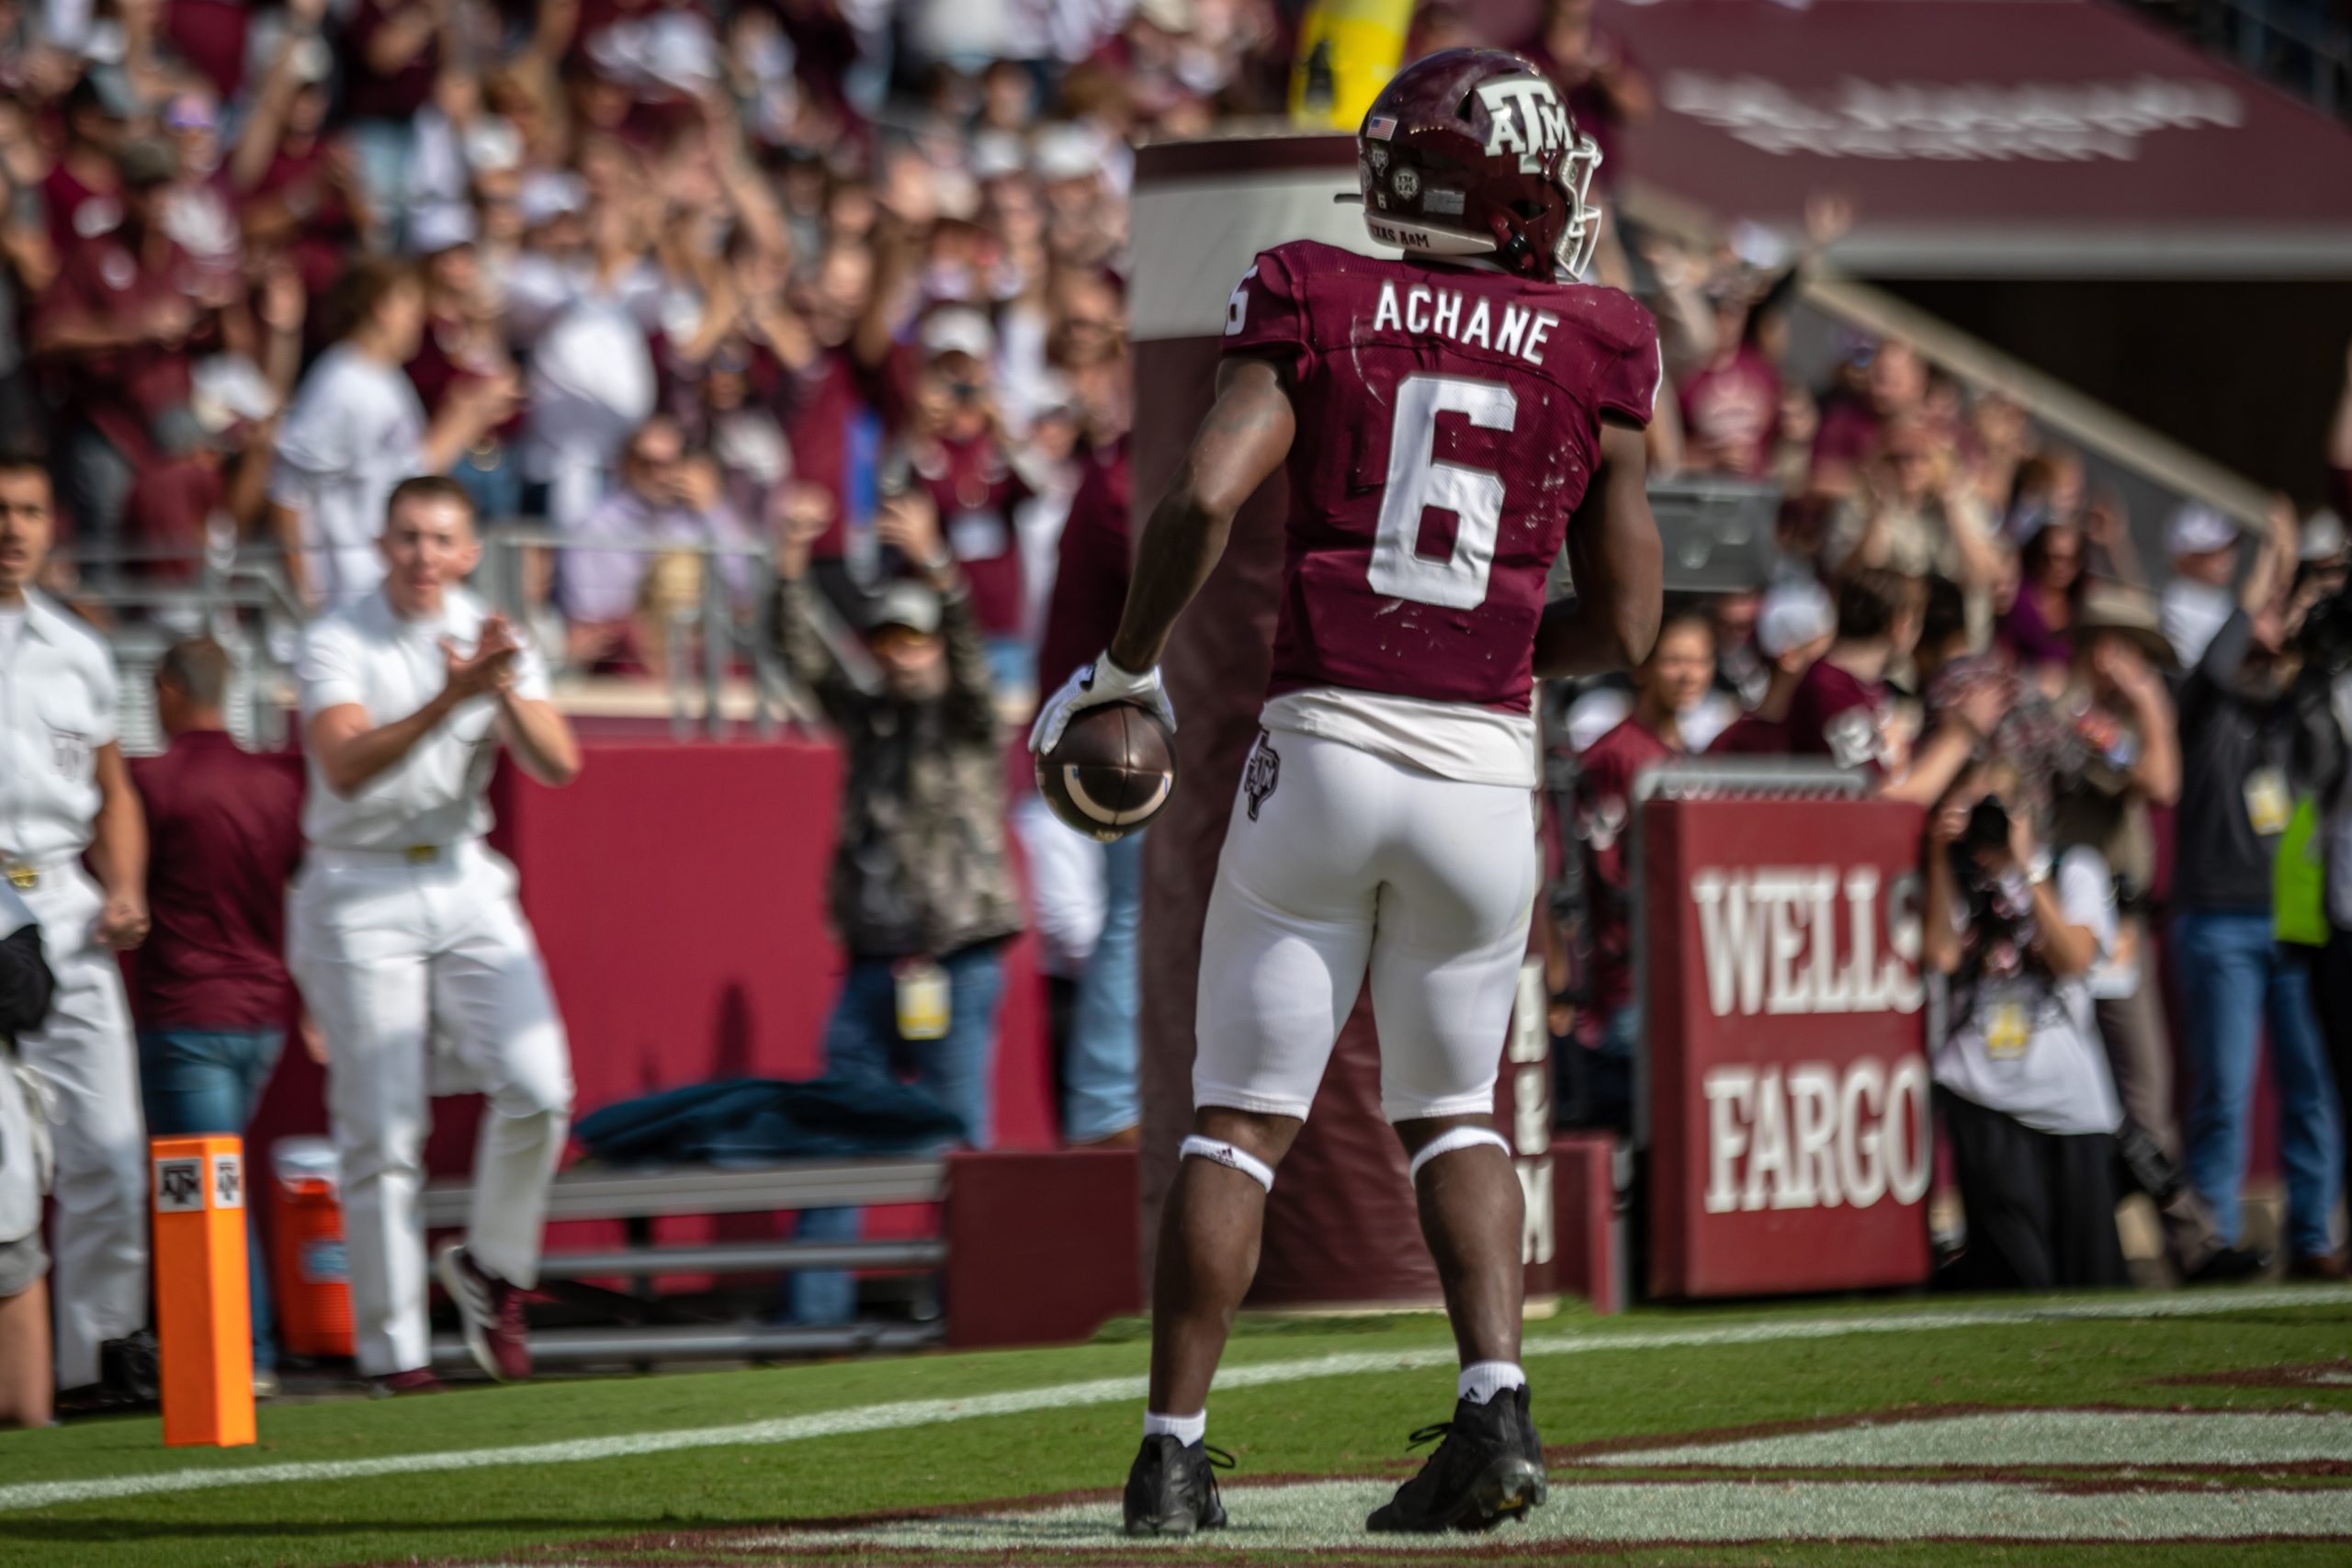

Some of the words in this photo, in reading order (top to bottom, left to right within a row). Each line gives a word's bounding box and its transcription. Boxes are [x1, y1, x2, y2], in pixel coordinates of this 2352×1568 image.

[1374, 283, 1559, 367] ACHANE
[1366, 375, 1518, 611] 6
[1692, 868, 1927, 1016] WELLS
[1704, 1056, 1931, 1213] FARGO
